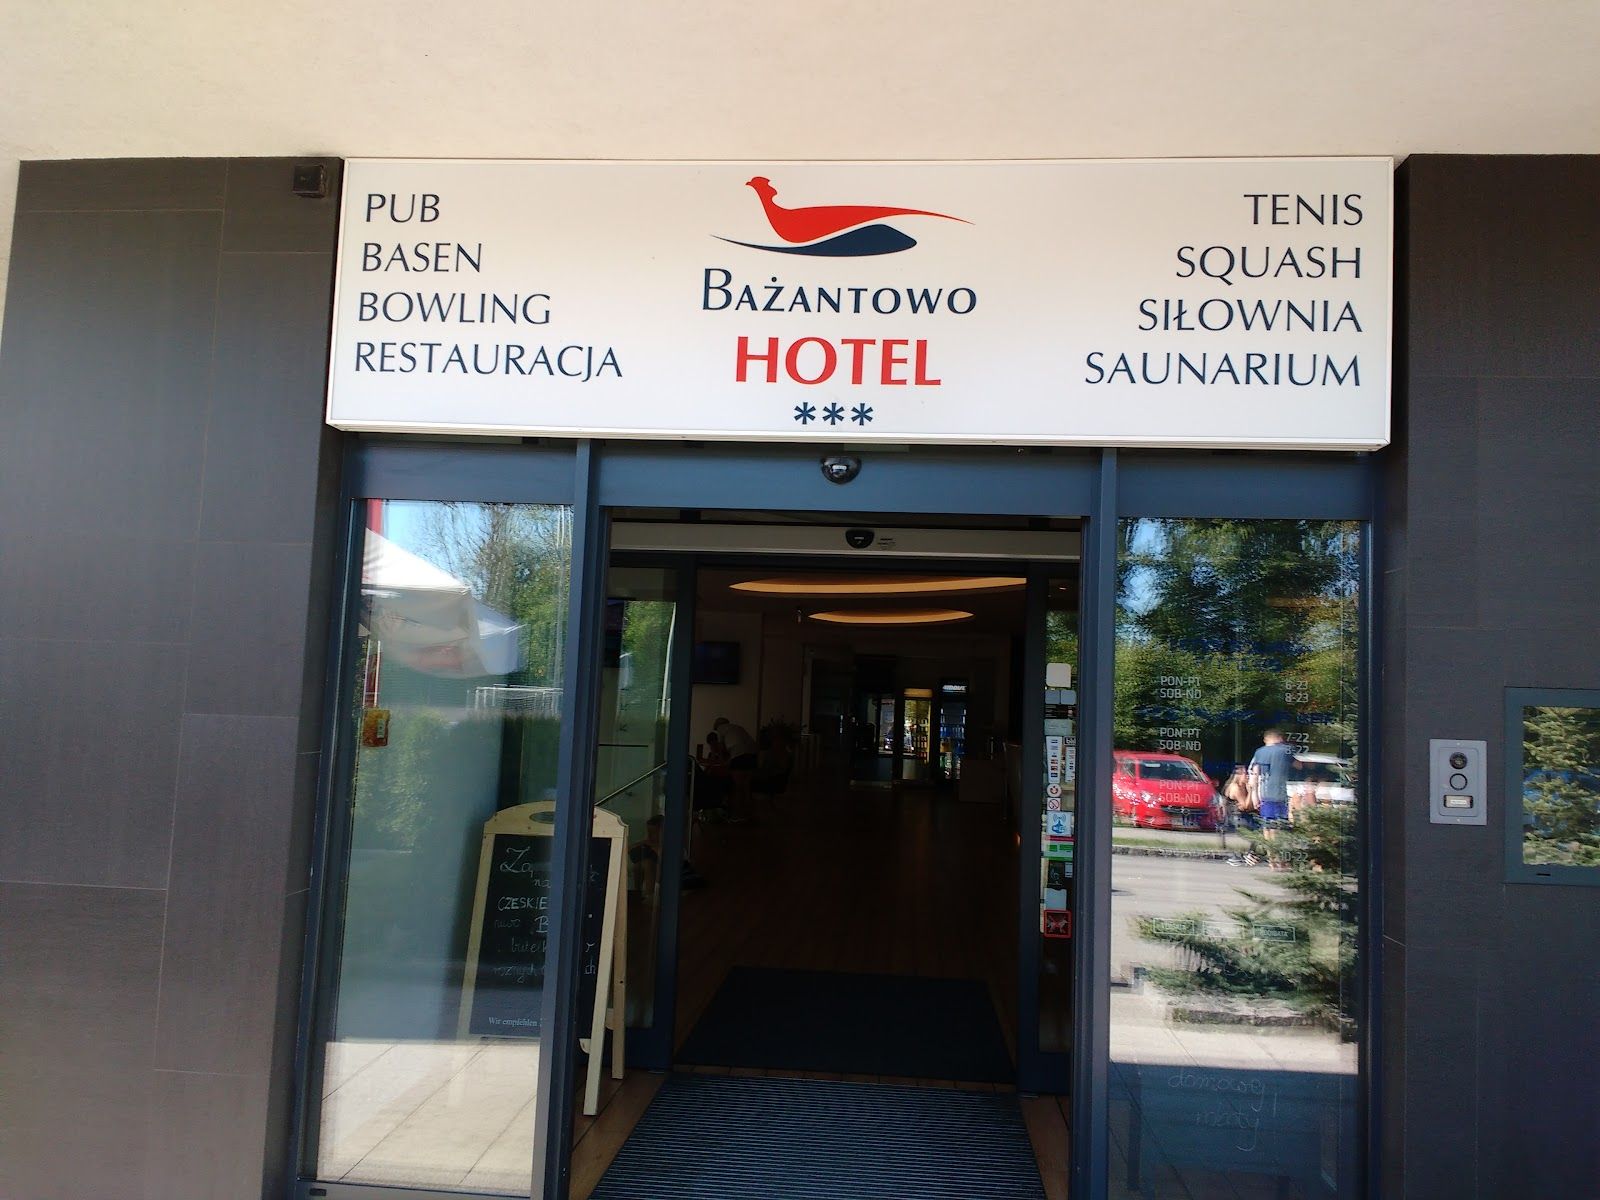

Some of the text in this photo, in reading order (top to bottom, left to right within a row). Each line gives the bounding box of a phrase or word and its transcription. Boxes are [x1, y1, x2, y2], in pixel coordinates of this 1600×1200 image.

[367, 194, 439, 222] PUB
[1244, 194, 1362, 225] TENIS
[363, 243, 481, 272] BASEN
[1177, 246, 1360, 285] SQUASH
[360, 293, 550, 324] BOWLING
[1139, 299, 1362, 332] SIŁOWNIA
[356, 343, 622, 382] RESTAURACJA
[736, 337, 940, 385] HOTEL
[1086, 352, 1359, 386] SAUNARIUM
[1159, 687, 1202, 700] SOB-ND
[1160, 675, 1201, 687] PON-PT
[1159, 727, 1201, 739] PON-PT
[1159, 740, 1201, 751] SOB-ND
